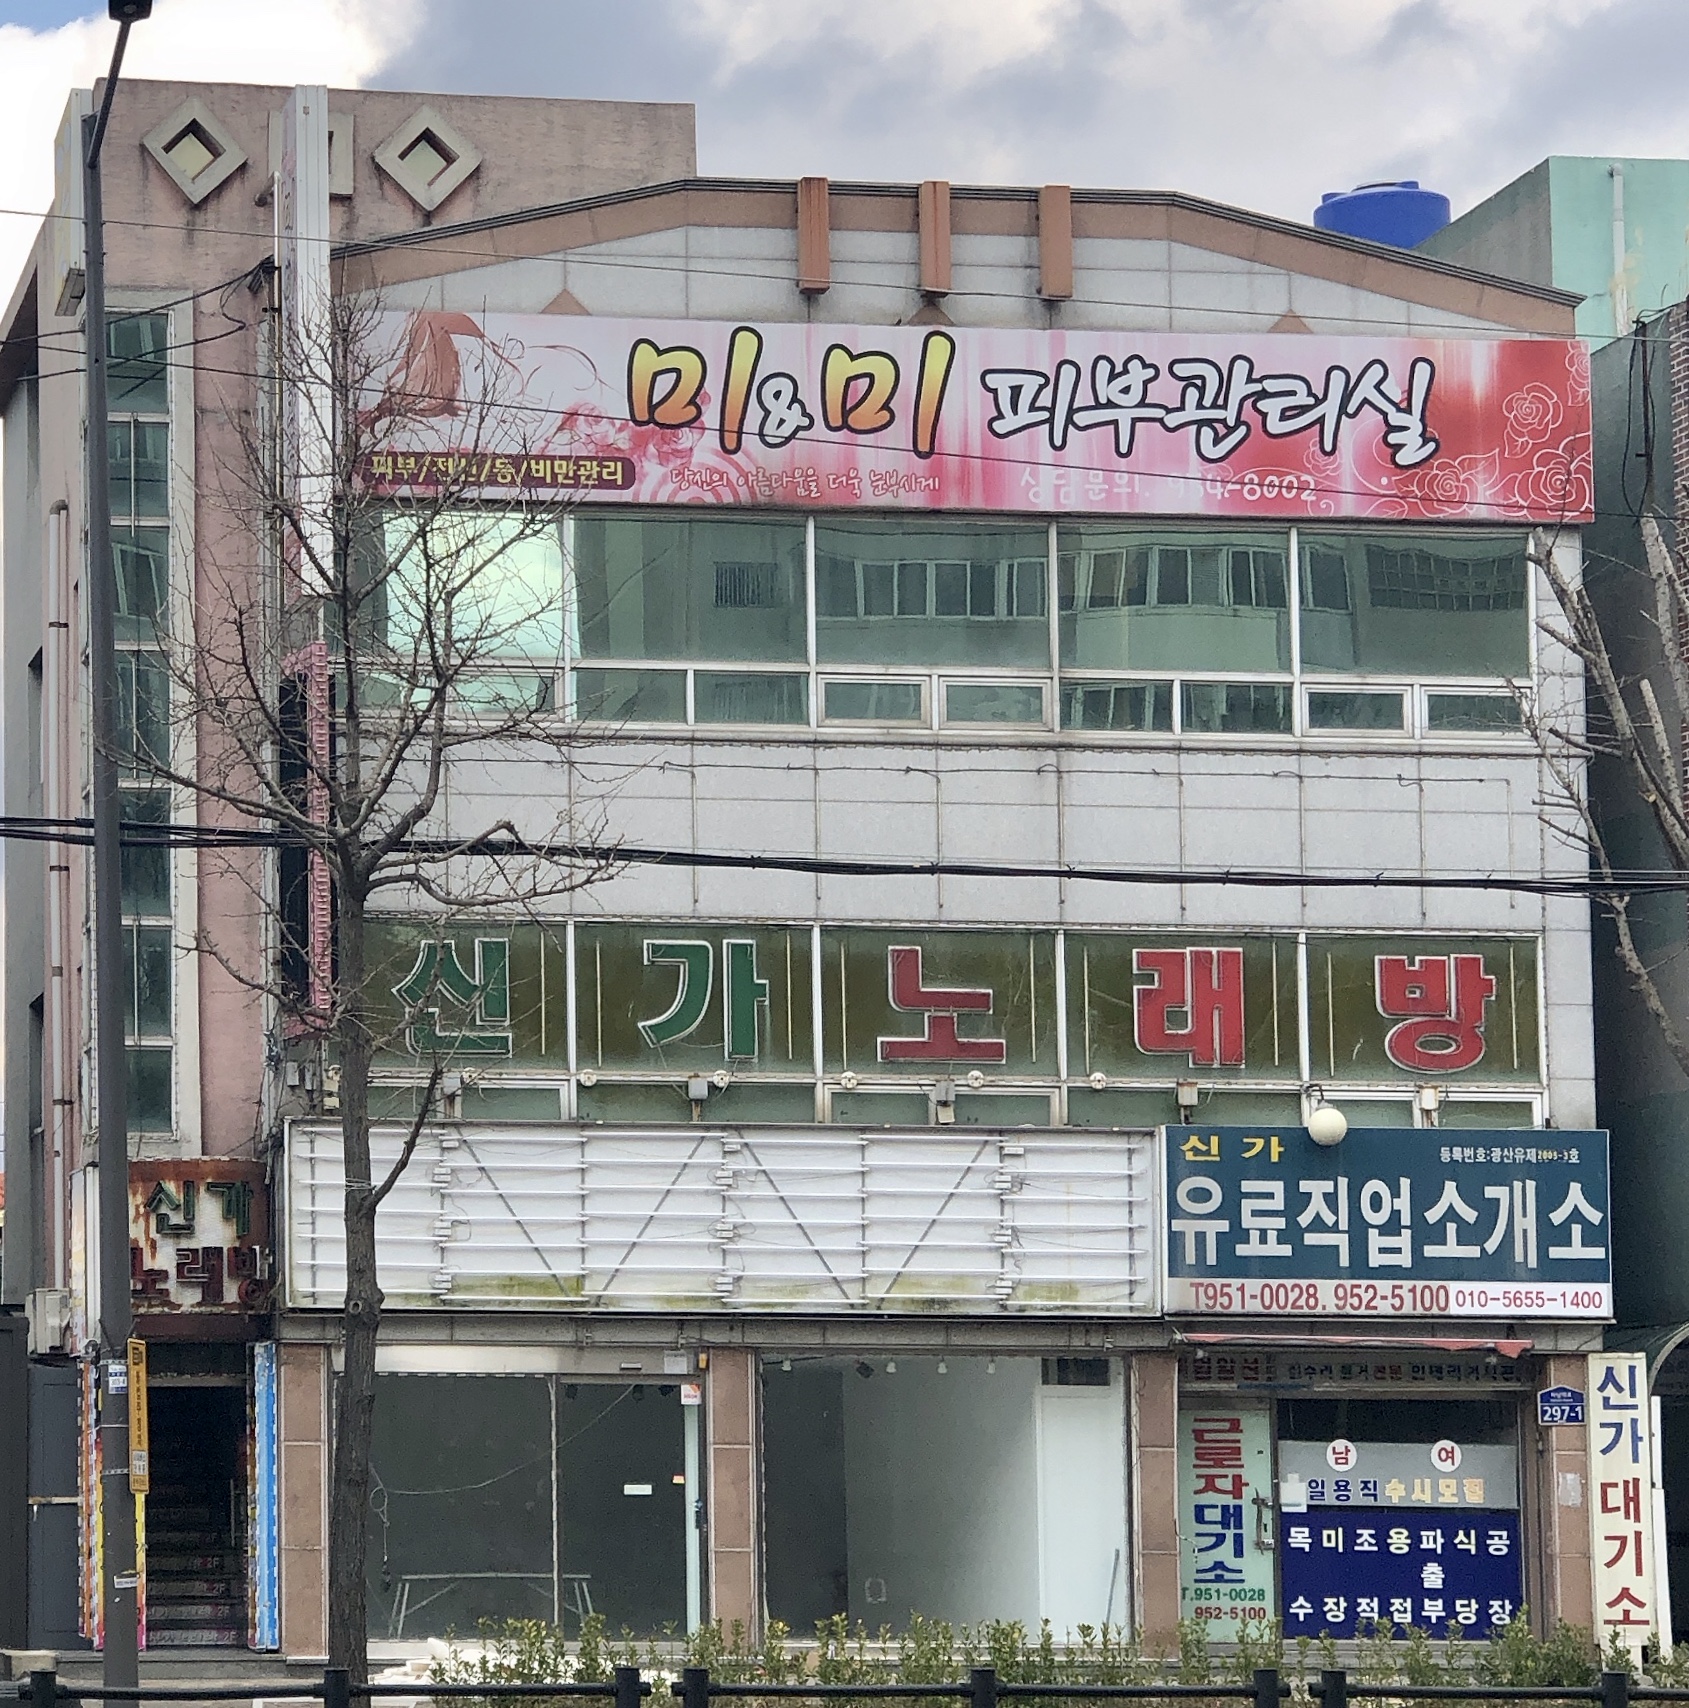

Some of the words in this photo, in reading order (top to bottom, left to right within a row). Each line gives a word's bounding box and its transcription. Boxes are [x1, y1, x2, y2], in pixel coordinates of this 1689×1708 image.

[628, 326, 955, 460] 미&미
[981, 354, 1438, 467] 피부관리실
[671, 466, 728, 490] 당신의
[737, 467, 821, 498] 아름다움을
[828, 469, 862, 497] 더욱
[869, 469, 939, 497] 눈부시게
[145, 1180, 255, 1237] 신가
[1171, 1176, 1607, 1268] 유료직업소개소
[1334, 1284, 1450, 1313] 952-5100
[1455, 1290, 1603, 1311] 010-5655-1400
[1542, 1406, 1583, 1422] 297-1
[1597, 1365, 1643, 1465] 신가
[1331, 1446, 1351, 1466] 남
[1437, 1446, 1457, 1467] 여
[1307, 1478, 1379, 1503] 일용직
[1600, 1478, 1650, 1626] 대기소
[1195, 1607, 1267, 1621] 952-5100
